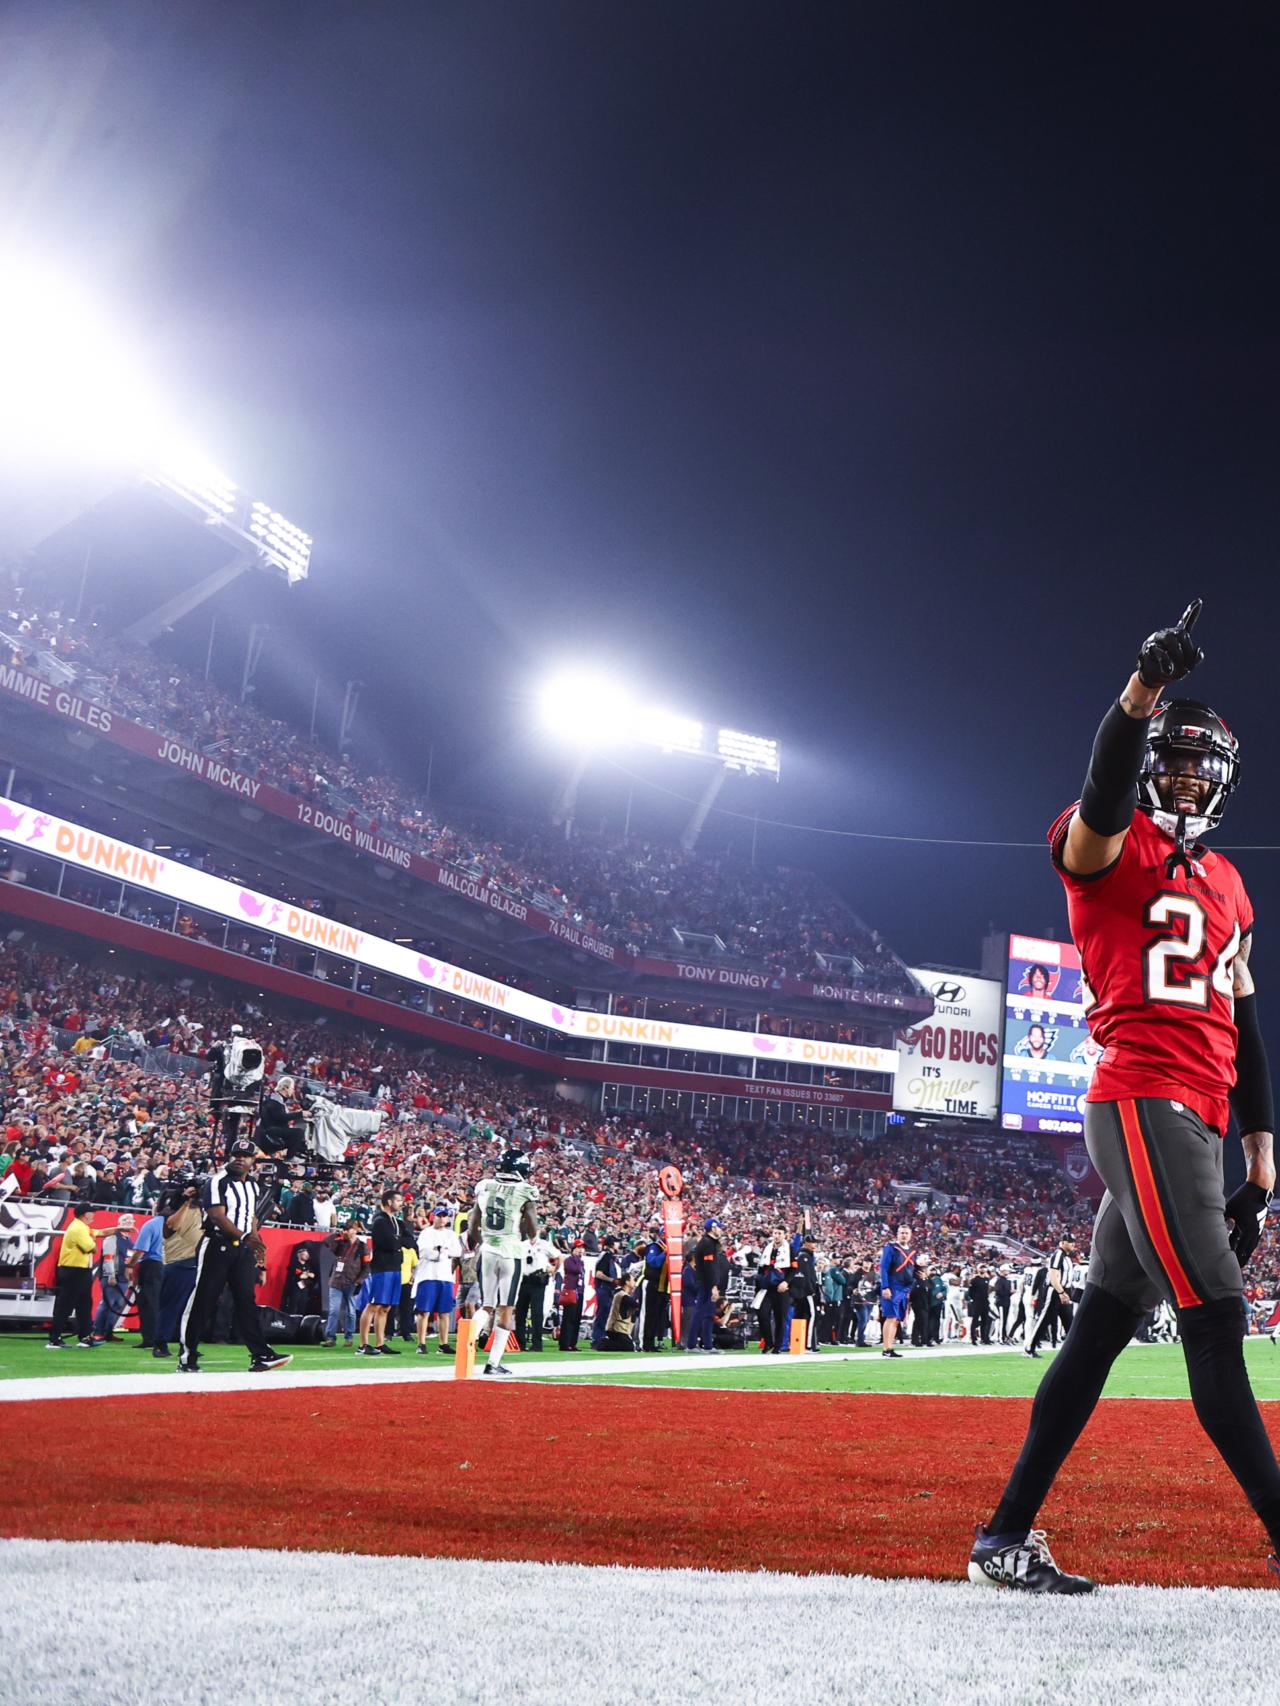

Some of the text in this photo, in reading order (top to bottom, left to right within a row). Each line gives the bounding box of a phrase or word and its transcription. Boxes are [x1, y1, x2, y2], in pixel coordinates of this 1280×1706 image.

[0, 665, 112, 732] MMIE GILES
[158, 740, 261, 798] JOHN MCKAY
[298, 804, 411, 869] 12 DOUG WILLIAMS
[56, 826, 164, 883] DUNKIN'
[438, 868, 527, 921] MALCOLM GLAZER
[287, 911, 363, 954] DUNKIN'
[560, 924, 580, 945] PAUL
[582, 935, 615, 960] GRUBER
[1143, 890, 1235, 1011] 24
[452, 972, 510, 1006] DUNKIN'
[677, 964, 769, 988] TONY DUNGY
[813, 984, 860, 1001] MONTE
[937, 1005, 971, 1017] UNDAI
[586, 1016, 679, 1042] DUNKIN'
[802, 1044, 884, 1066] DUNKIN'
[921, 1025, 998, 1066] GO BUCS
[923, 1066, 940, 1078] IT'S
[745, 1084, 764, 1094] TEXT
[766, 1087, 781, 1096] FAN
[783, 1089, 811, 1099] ISSUES
[813, 1092, 823, 1100] TO
[908, 1077, 979, 1106] Miller
[945, 1098, 978, 1115] TIME
[1027, 1090, 1076, 1106] MOFFITT
